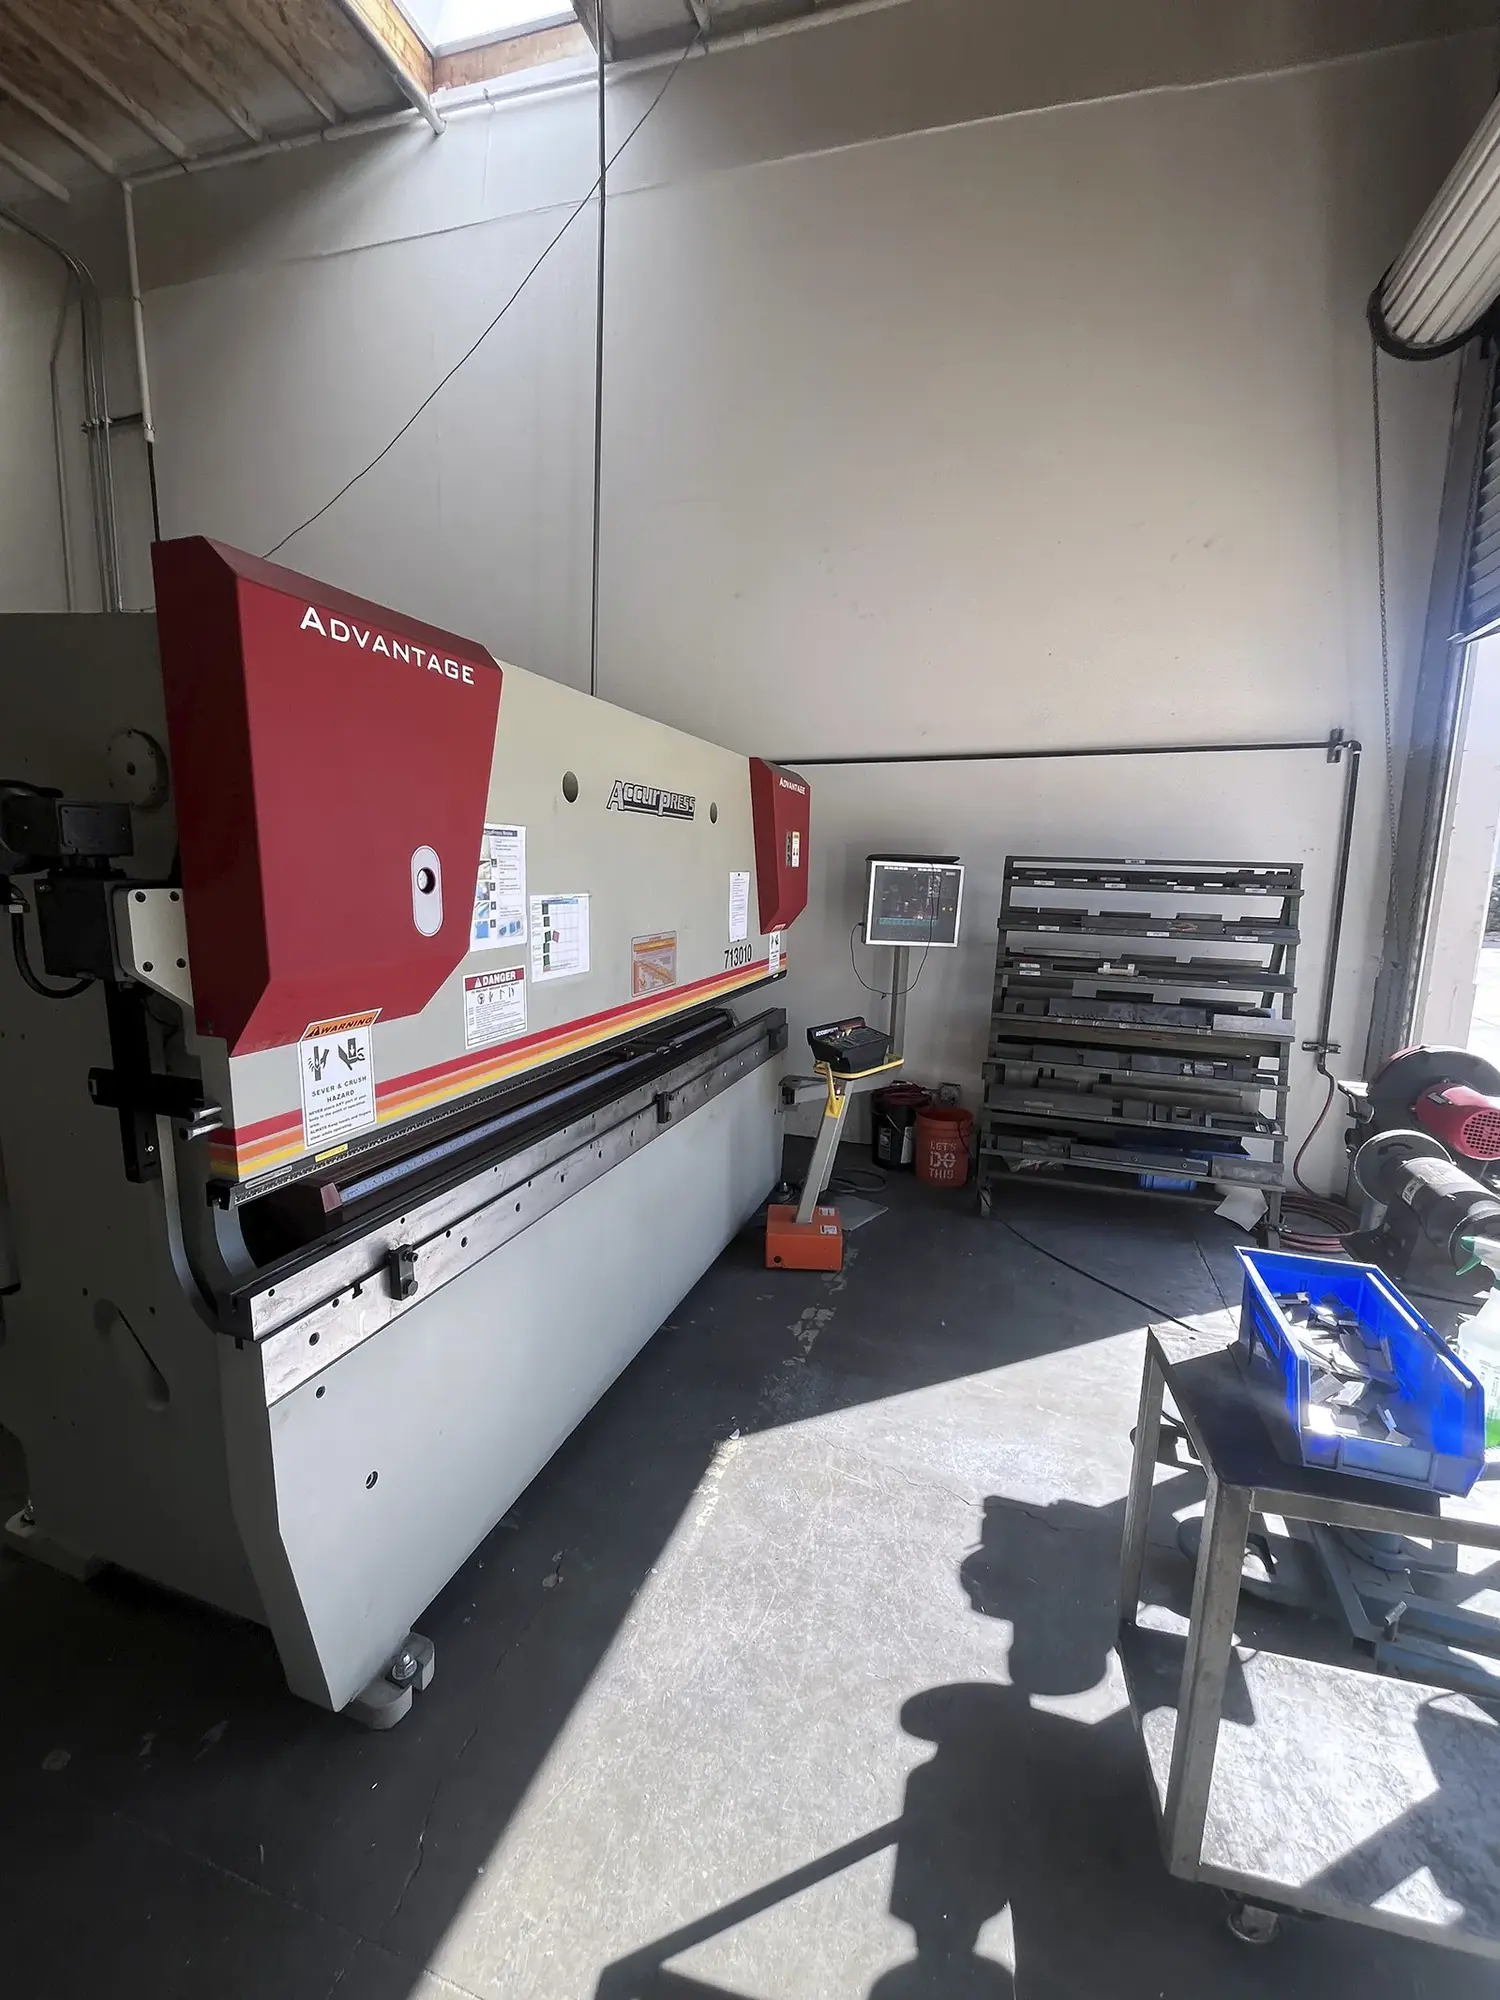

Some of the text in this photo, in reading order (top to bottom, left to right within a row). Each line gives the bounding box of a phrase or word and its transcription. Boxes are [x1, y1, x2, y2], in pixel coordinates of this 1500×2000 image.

[300, 606, 475, 685] ADVANTAGE
[724, 944, 752, 969] 713010
[483, 970, 516, 986] DANGER
[321, 1017, 372, 1034] WARNING
[312, 1085, 335, 1097] SEVER
[344, 1076, 367, 1087] CRUSH
[327, 1089, 354, 1102] HAZARD
[929, 1167, 954, 1179] THIS
